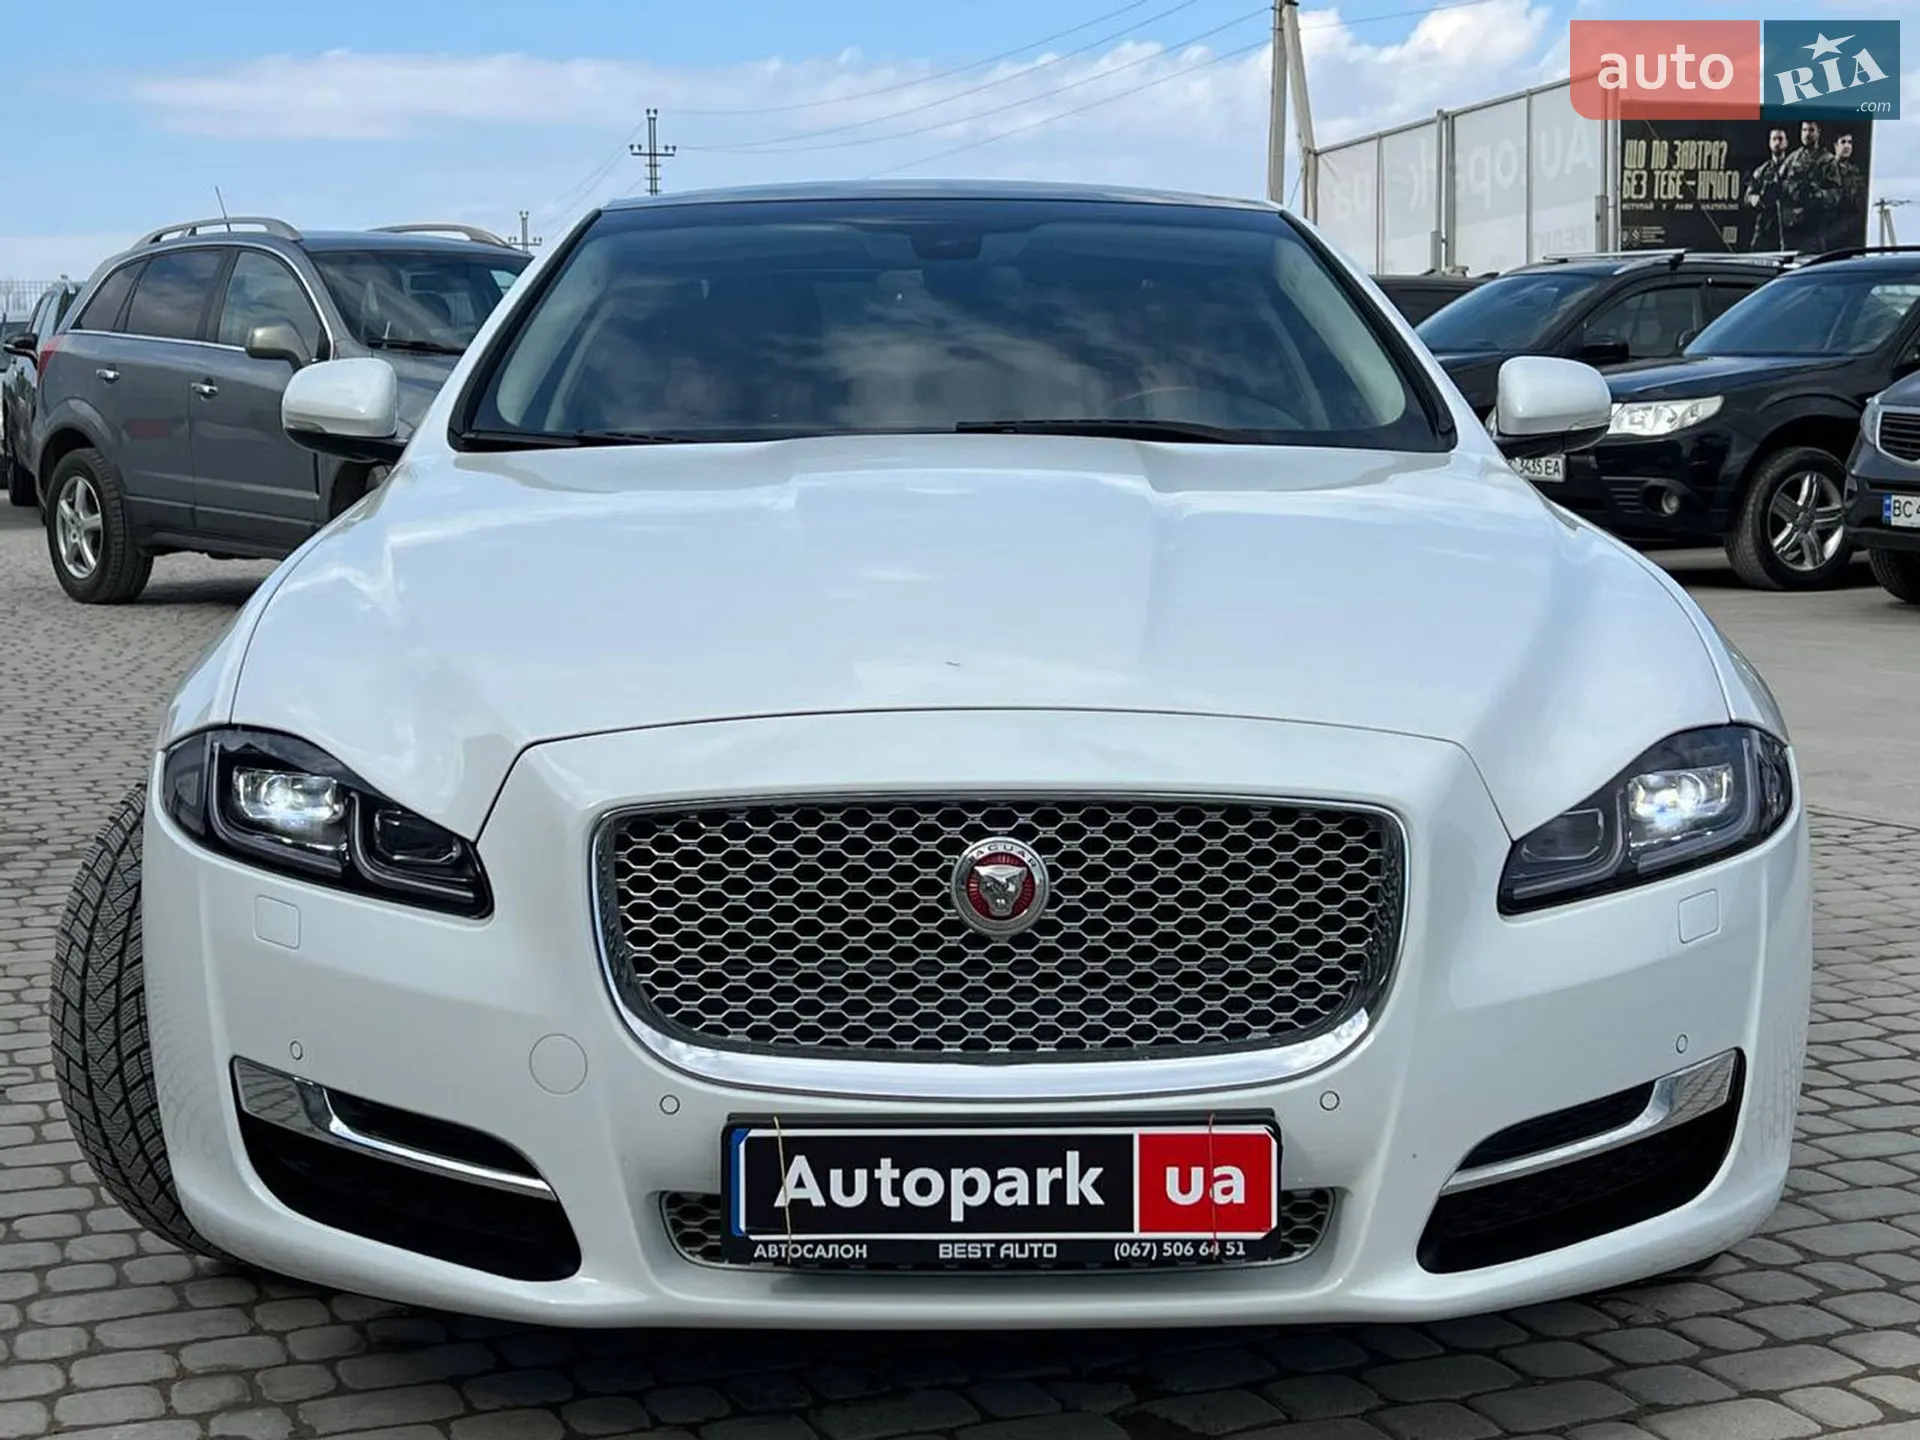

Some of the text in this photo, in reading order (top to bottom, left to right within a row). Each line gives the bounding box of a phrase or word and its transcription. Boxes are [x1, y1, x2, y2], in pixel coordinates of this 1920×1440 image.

[1651, 140, 1668, 169] ПО
[1672, 140, 1728, 170] ЗАВТРА?
[1622, 170, 1647, 200] БЕЗ
[1893, 499, 1913, 518] BC
[773, 1151, 1245, 1222] Autopark ua
[753, 1243, 868, 1259] АВТОСАЛОН
[938, 1242, 1058, 1259] BEST AUTO
[1114, 1241, 1158, 1261] (067)
[1162, 1241, 1194, 1257] 506
[1225, 1241, 1246, 1256] 51
